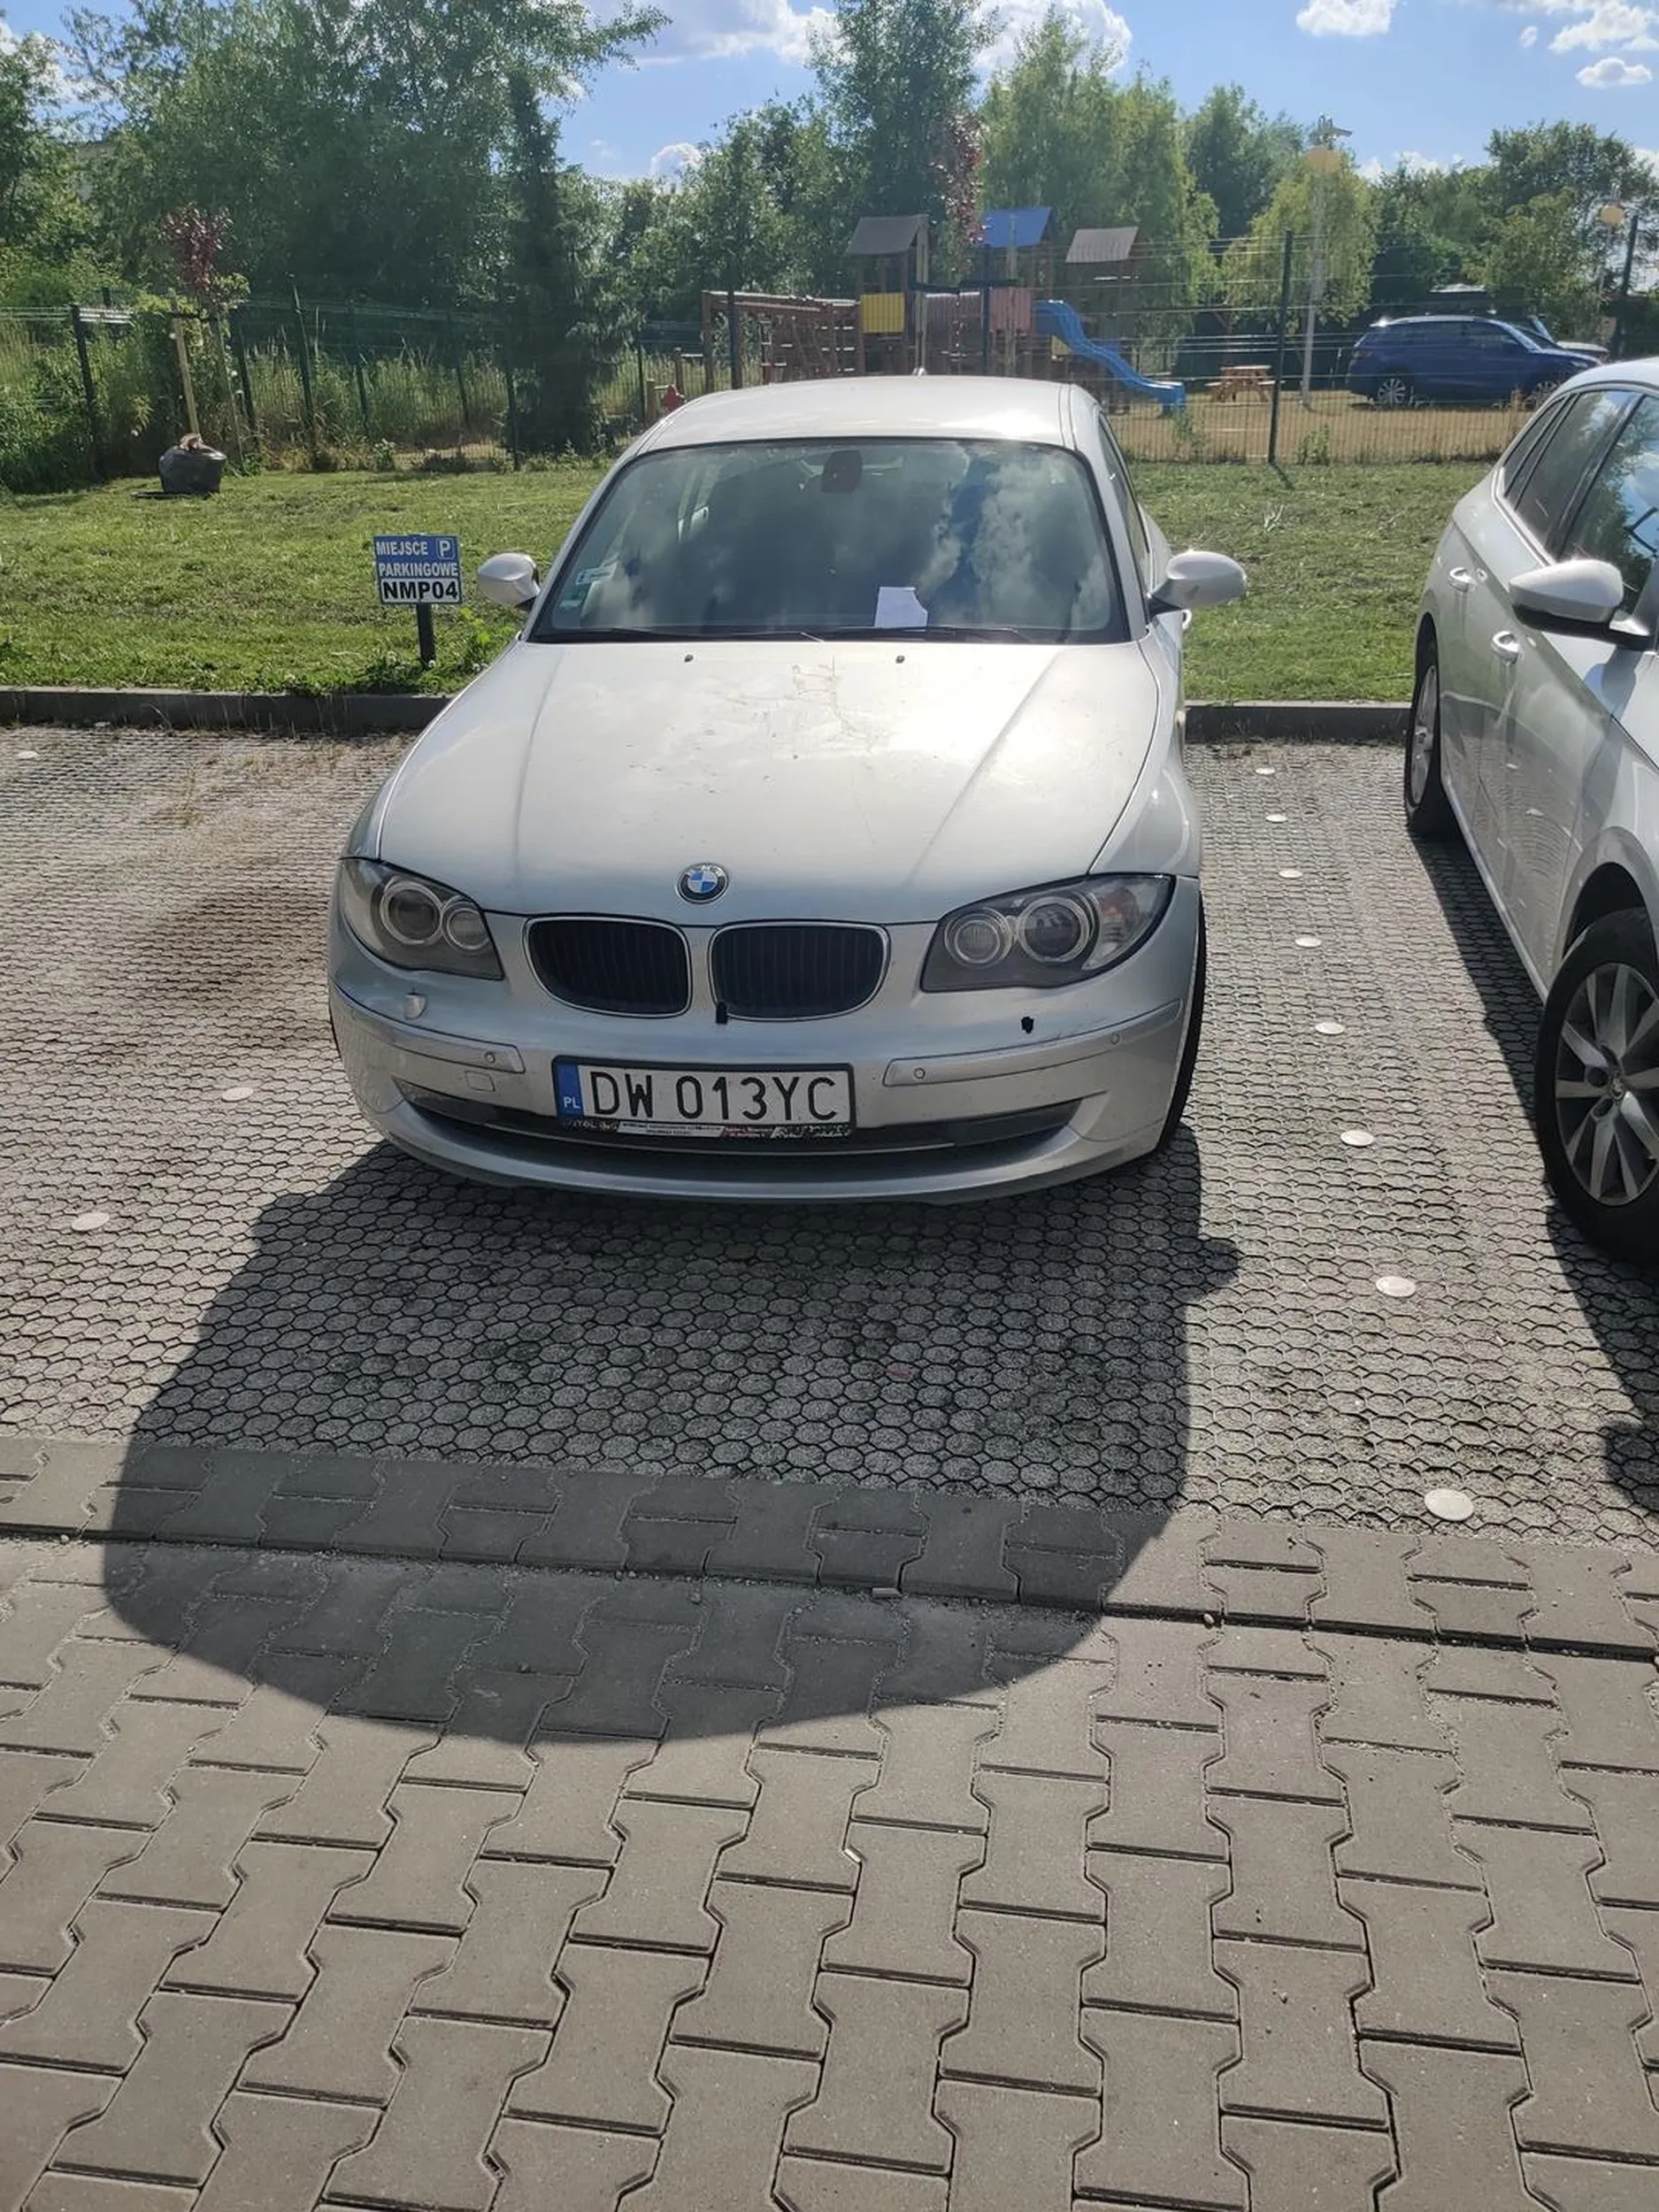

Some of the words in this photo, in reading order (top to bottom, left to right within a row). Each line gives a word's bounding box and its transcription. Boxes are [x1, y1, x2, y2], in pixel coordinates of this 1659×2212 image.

[375, 541, 428, 556] MIEJSCE
[439, 540, 451, 557] P
[379, 562, 458, 577] PARKINGOWE
[382, 580, 458, 599] NMP04
[563, 1096, 580, 1109] PL
[590, 1071, 654, 1118] DW
[675, 1075, 837, 1121] 013YC
